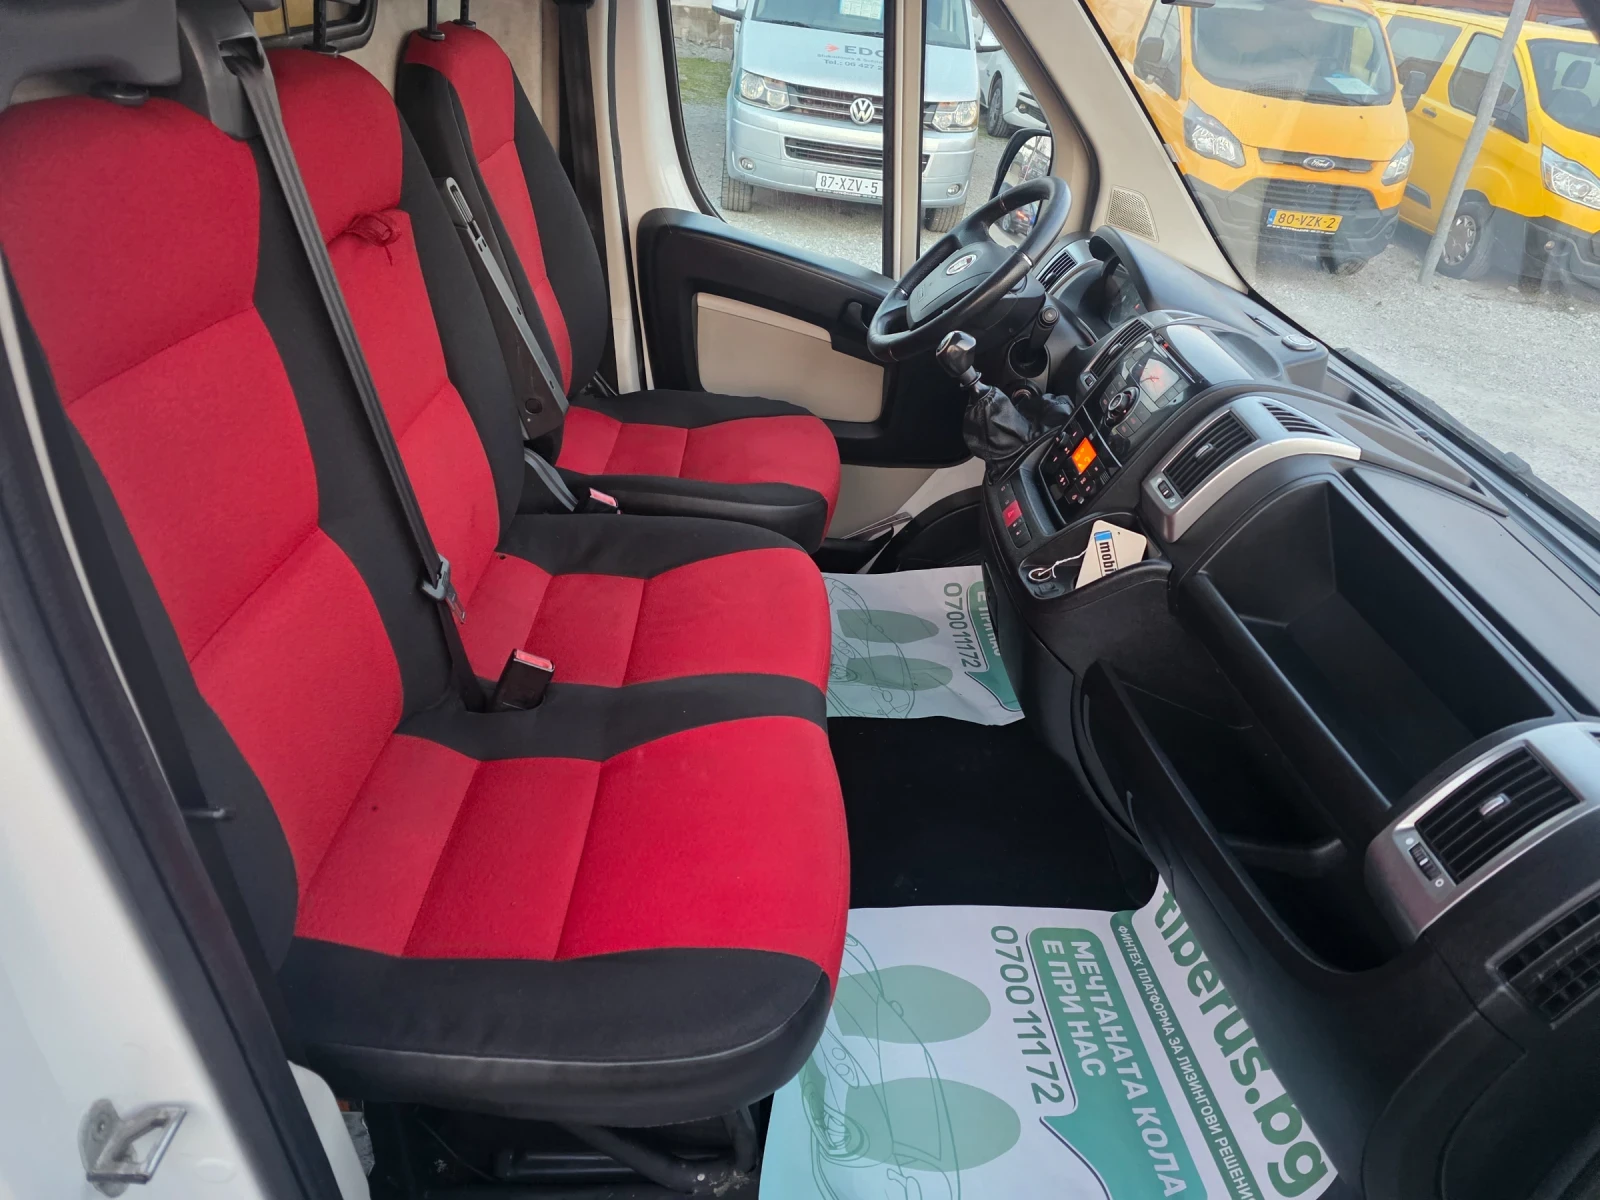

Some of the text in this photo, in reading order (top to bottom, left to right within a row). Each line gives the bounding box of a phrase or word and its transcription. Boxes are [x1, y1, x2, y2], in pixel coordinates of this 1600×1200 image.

[820, 175, 879, 195] 87-XZV-5
[1277, 212, 1337, 229] 80-VZK-2
[990, 925, 1035, 1005] 0700
[1048, 960, 1086, 1014] ПРИ
[1067, 1020, 1107, 1077] НАС
[1117, 925, 1256, 1200] ФИНТЕХ ПЛАТФОРМА ЗА ЛИЗИНГОВИ РЕШЕНИ
[1070, 941, 1188, 1198] МЕЧТАНАТА КОЛА
